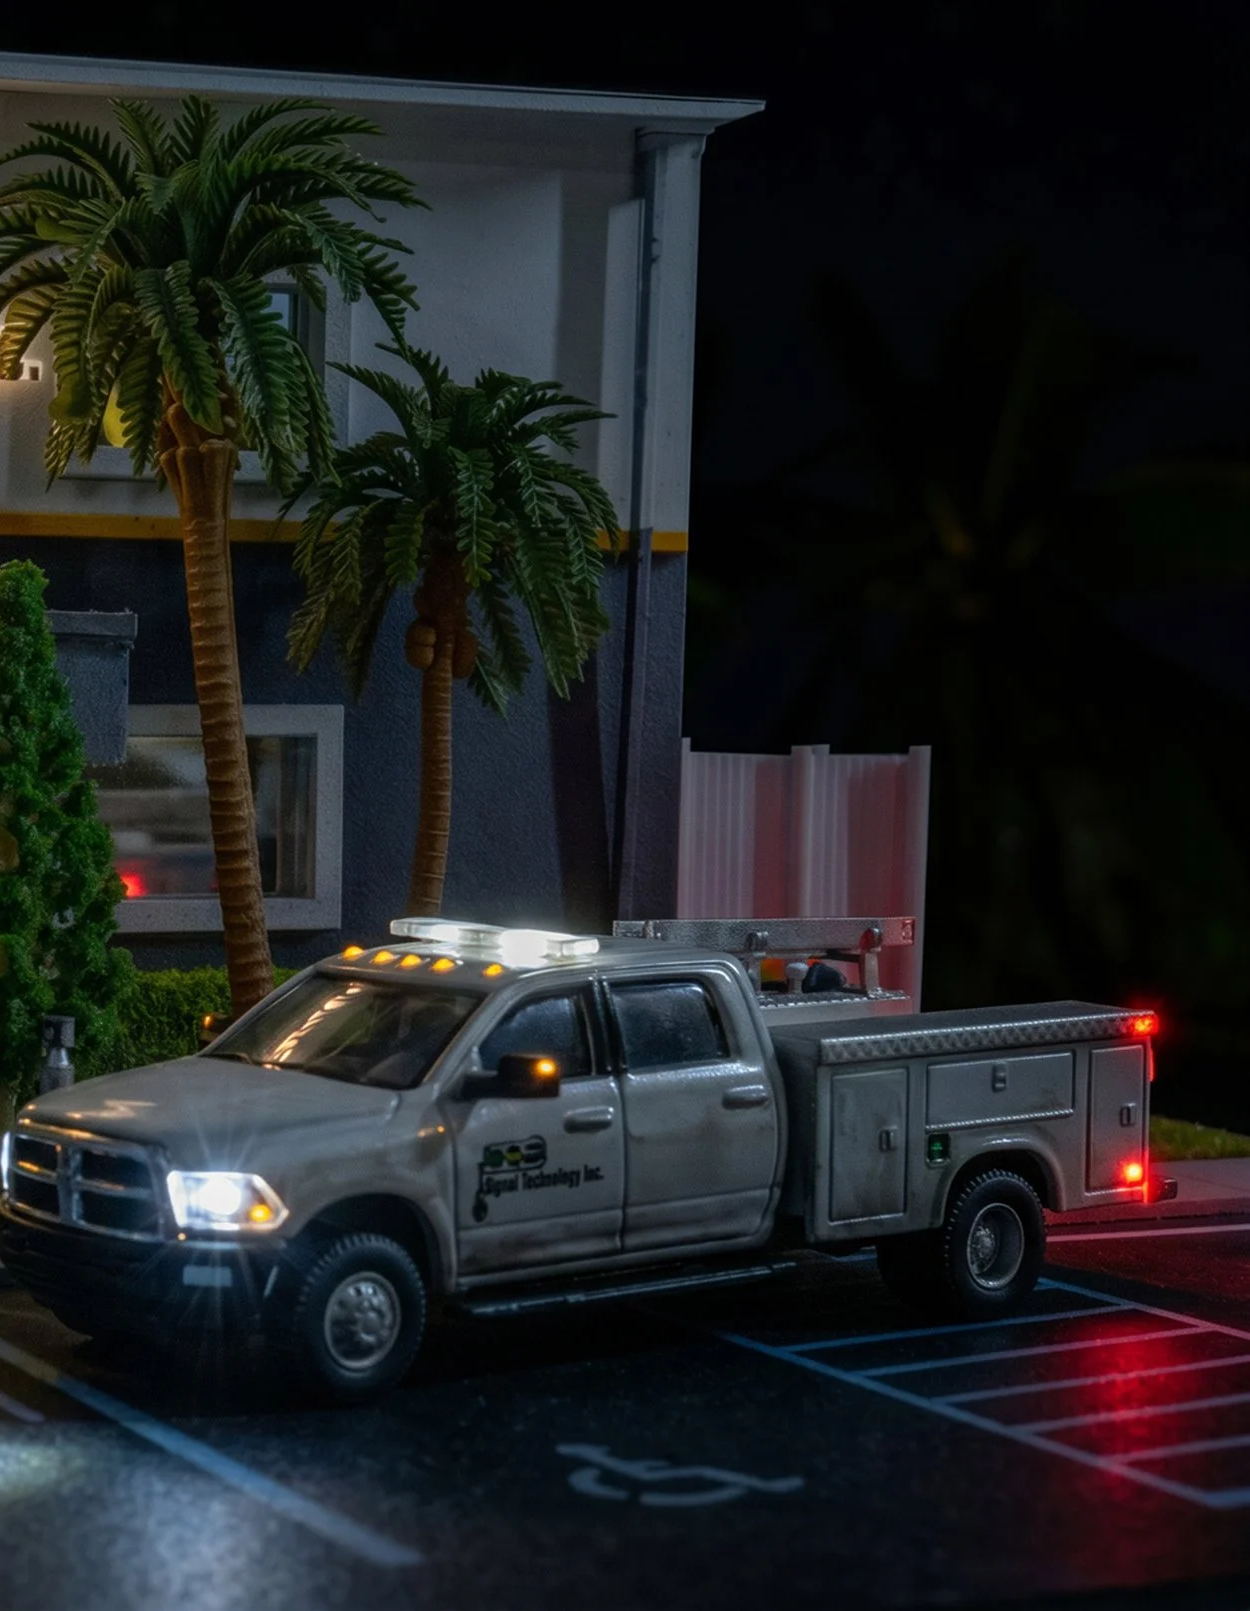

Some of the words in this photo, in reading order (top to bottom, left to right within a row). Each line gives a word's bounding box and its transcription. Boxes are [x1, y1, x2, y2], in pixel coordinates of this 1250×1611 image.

[485, 1174, 519, 1197] Signal
[522, 1167, 581, 1190] Technology
[584, 1163, 605, 1182] Inc.
